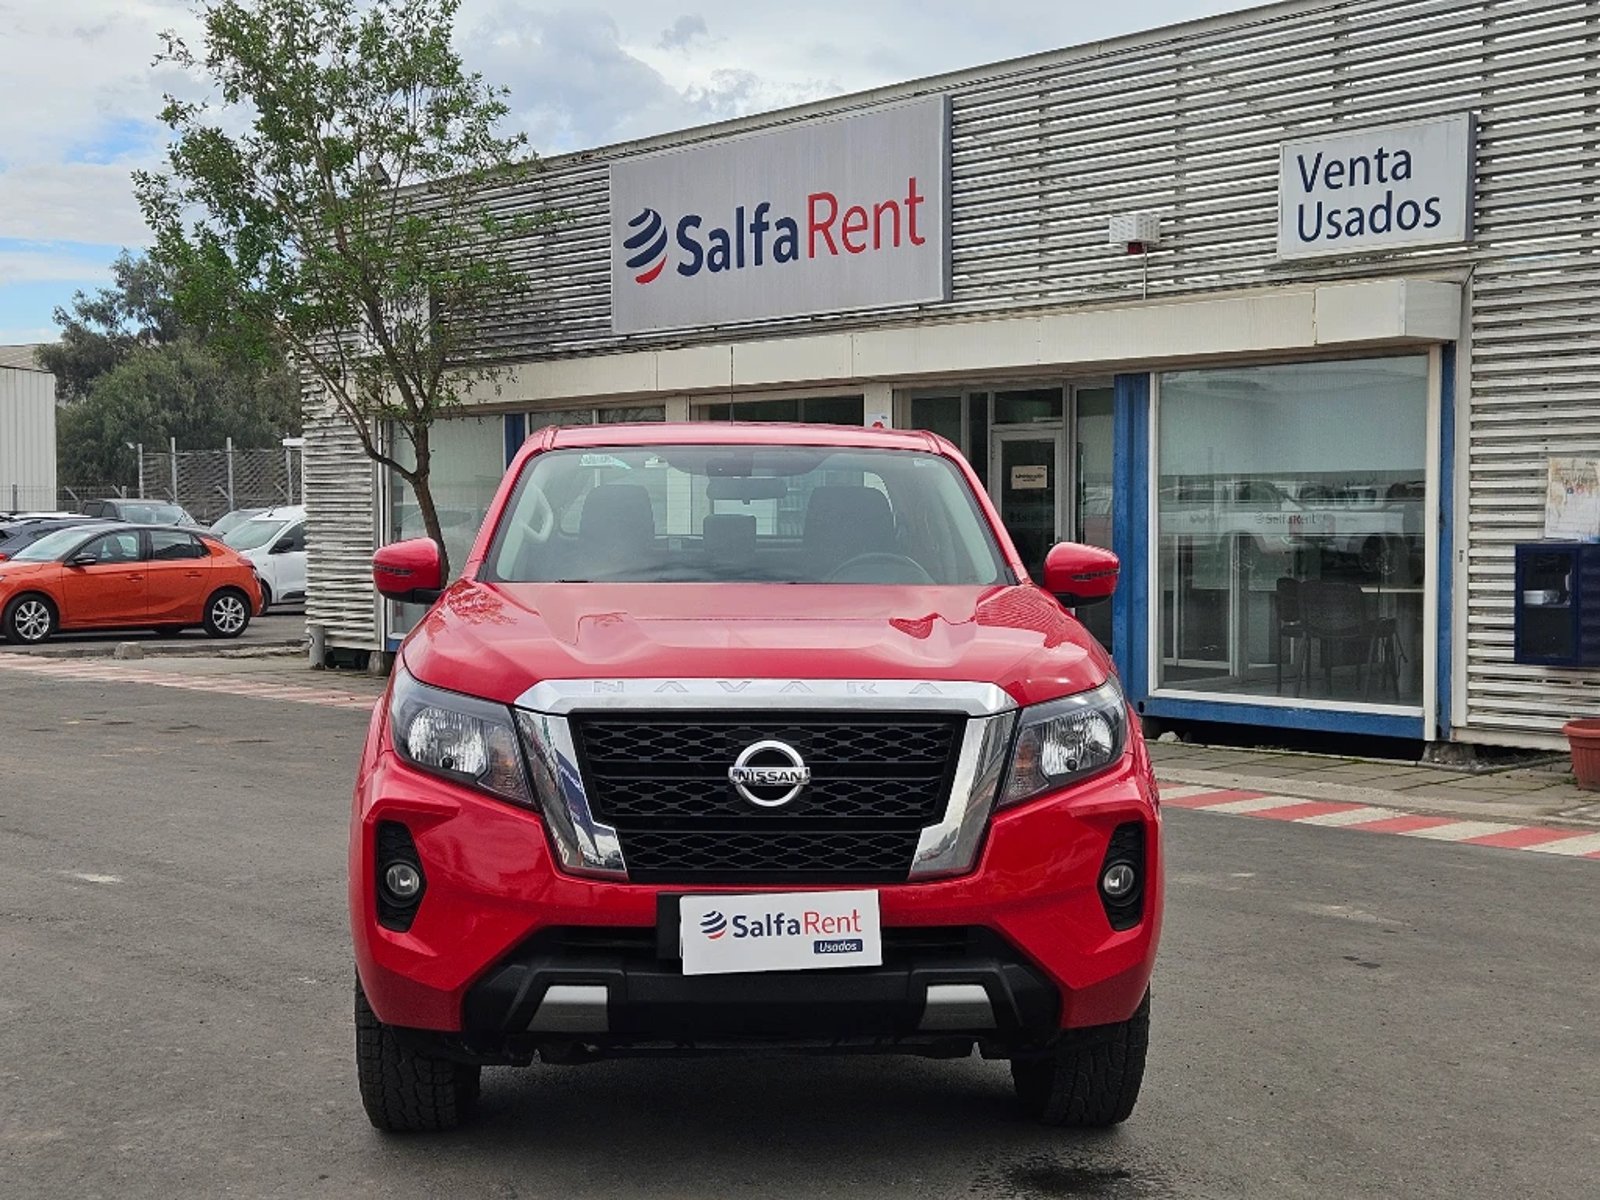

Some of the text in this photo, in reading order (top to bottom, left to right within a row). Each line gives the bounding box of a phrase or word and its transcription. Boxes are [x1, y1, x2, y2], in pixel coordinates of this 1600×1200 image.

[1297, 147, 1412, 193] Venta
[676, 177, 925, 277] SalfaRent
[1298, 190, 1441, 242] Usados
[594, 680, 944, 694] NAVARA
[738, 771, 803, 781] NISSAN
[732, 909, 862, 938] SalfaRent
[819, 940, 857, 952] Usados
